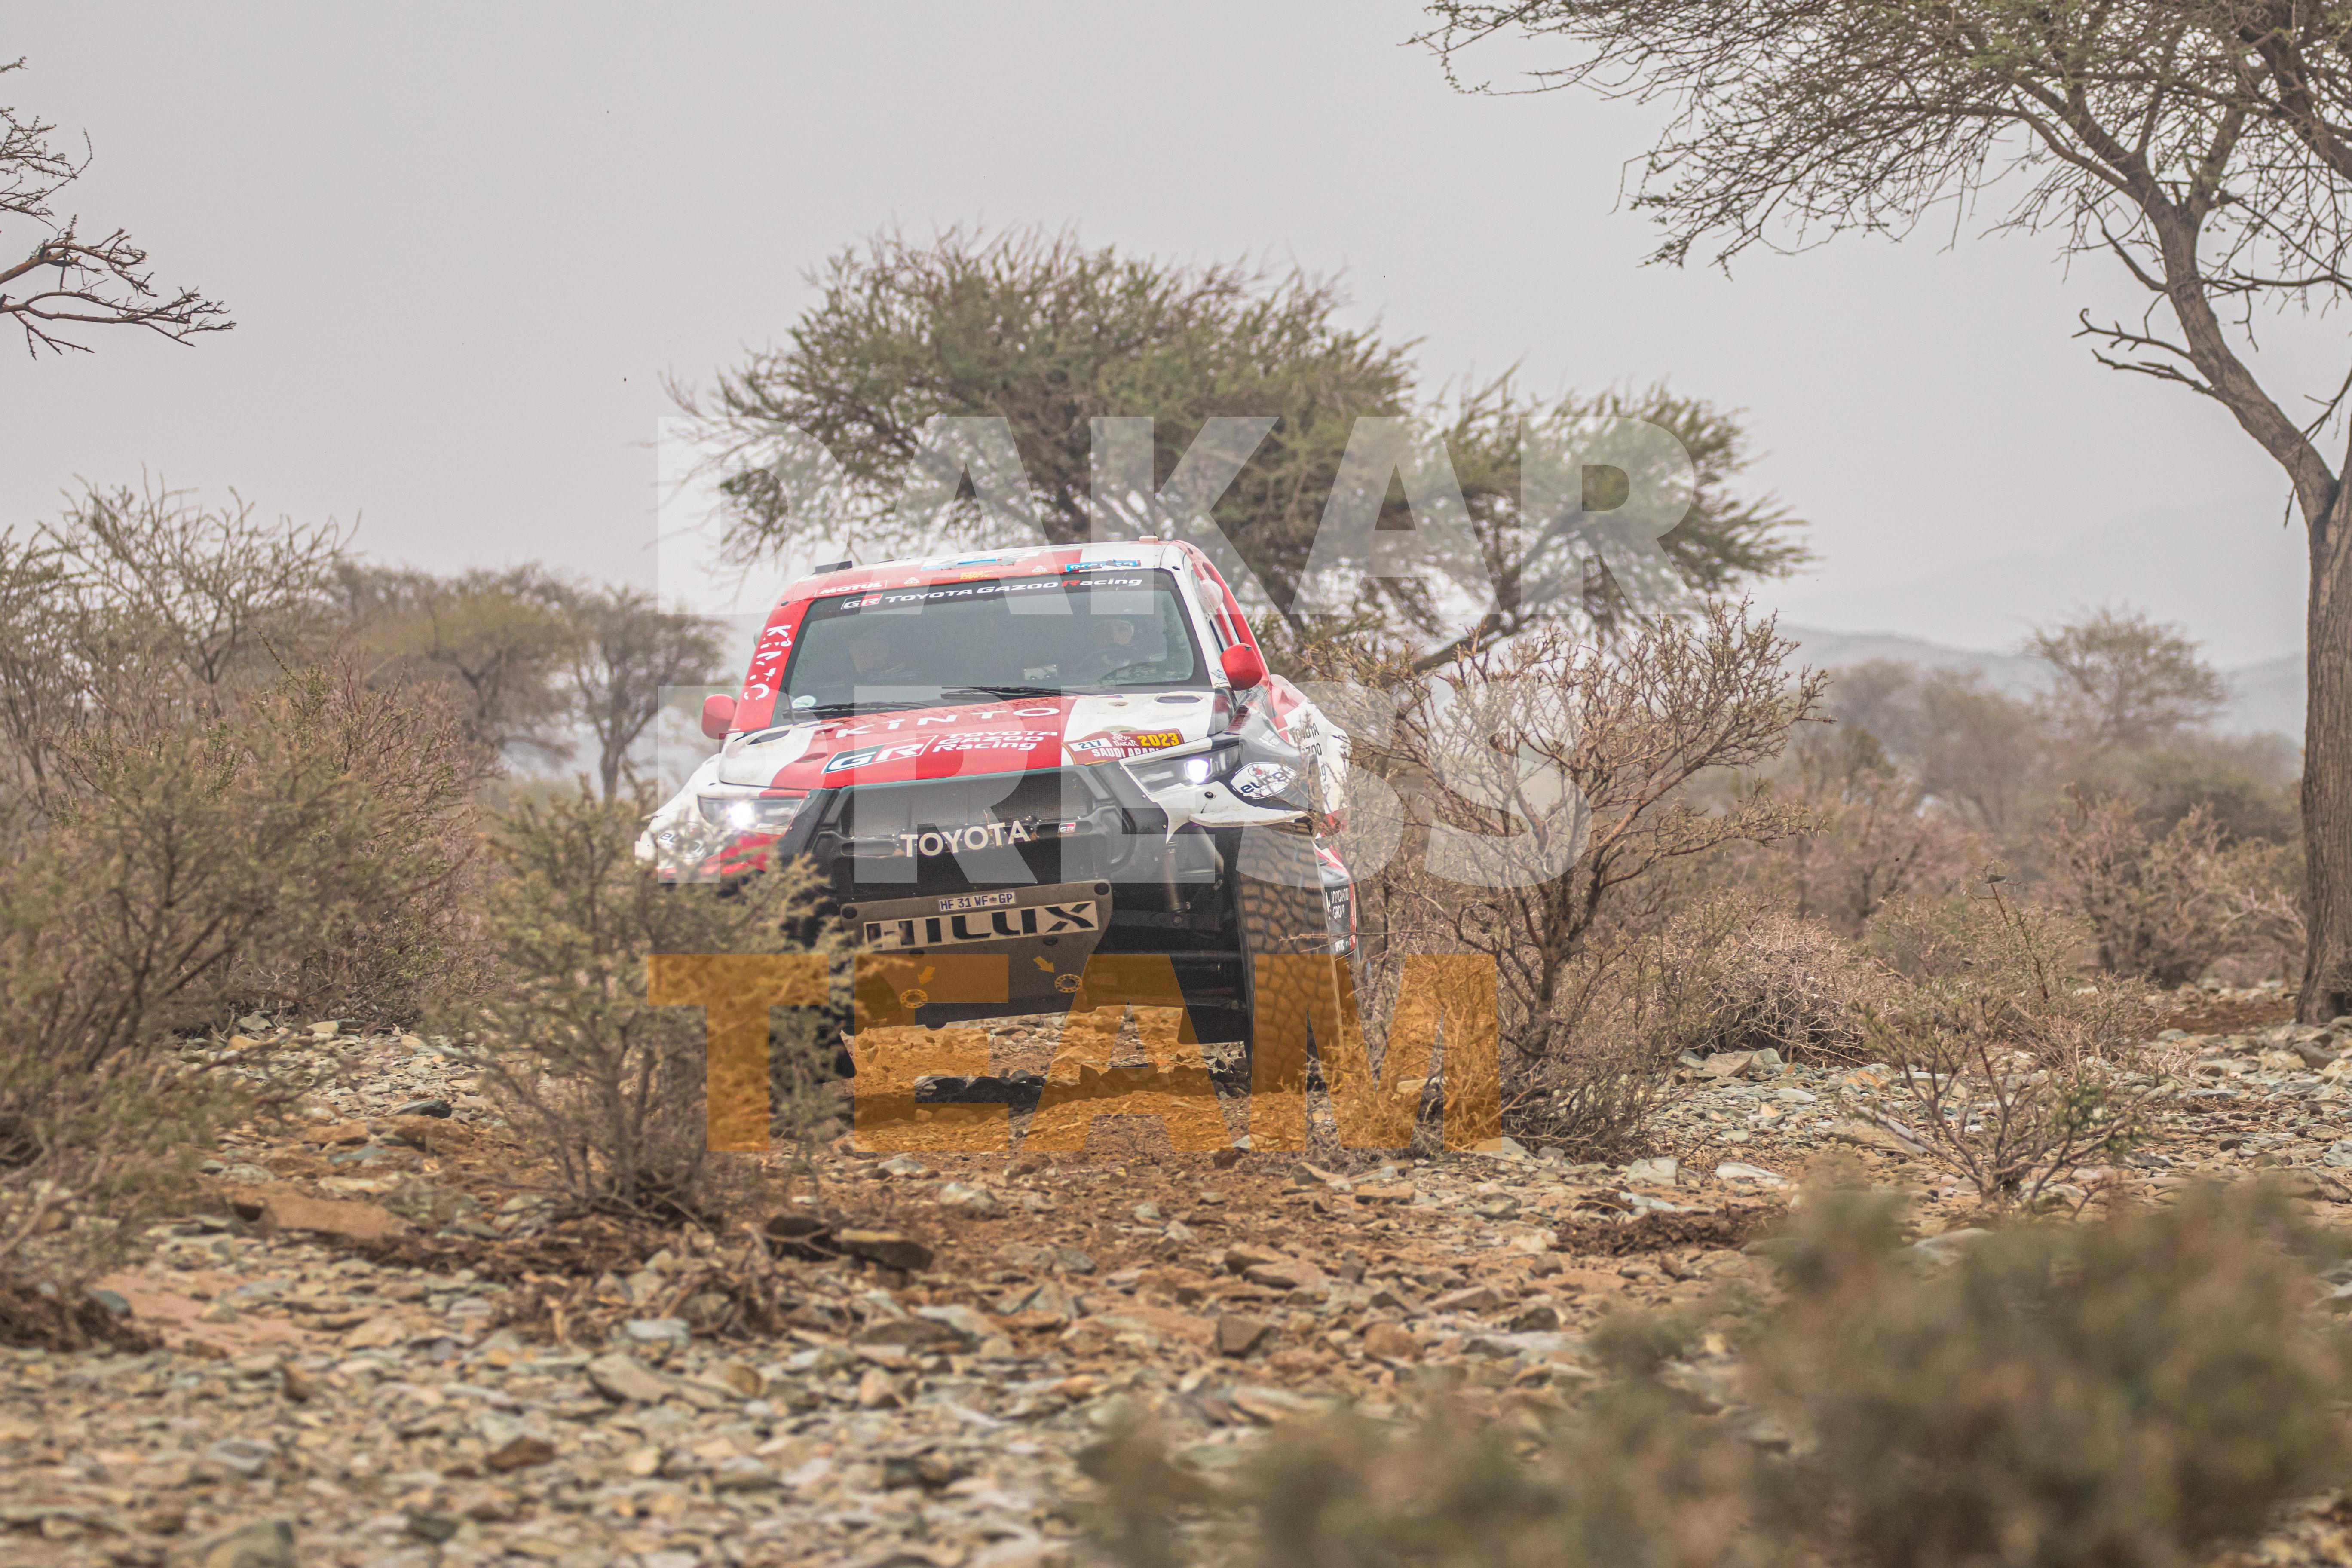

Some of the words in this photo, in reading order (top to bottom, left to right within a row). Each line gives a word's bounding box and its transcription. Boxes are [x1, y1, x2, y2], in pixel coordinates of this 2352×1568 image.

[819, 582, 882, 595] MOTUL
[842, 598, 879, 609] GR
[885, 589, 973, 603] TOYOTA
[977, 582, 1059, 594] GAZOO
[1062, 578, 1142, 587] Racing
[937, 736, 1044, 745] GAZOO
[945, 731, 1058, 739] TOYOTA
[1137, 733, 1180, 747] 2023
[932, 741, 1037, 752] Racing
[1078, 740, 1102, 749] 217
[828, 743, 924, 771] GR
[1091, 748, 1126, 758] SAUDI
[900, 820, 1031, 857] TOYOTA
[940, 899, 954, 910] HF
[957, 897, 972, 908] 31
[974, 895, 988, 906] WF
[998, 893, 1013, 903] GP
[866, 902, 1095, 948] HILUX
